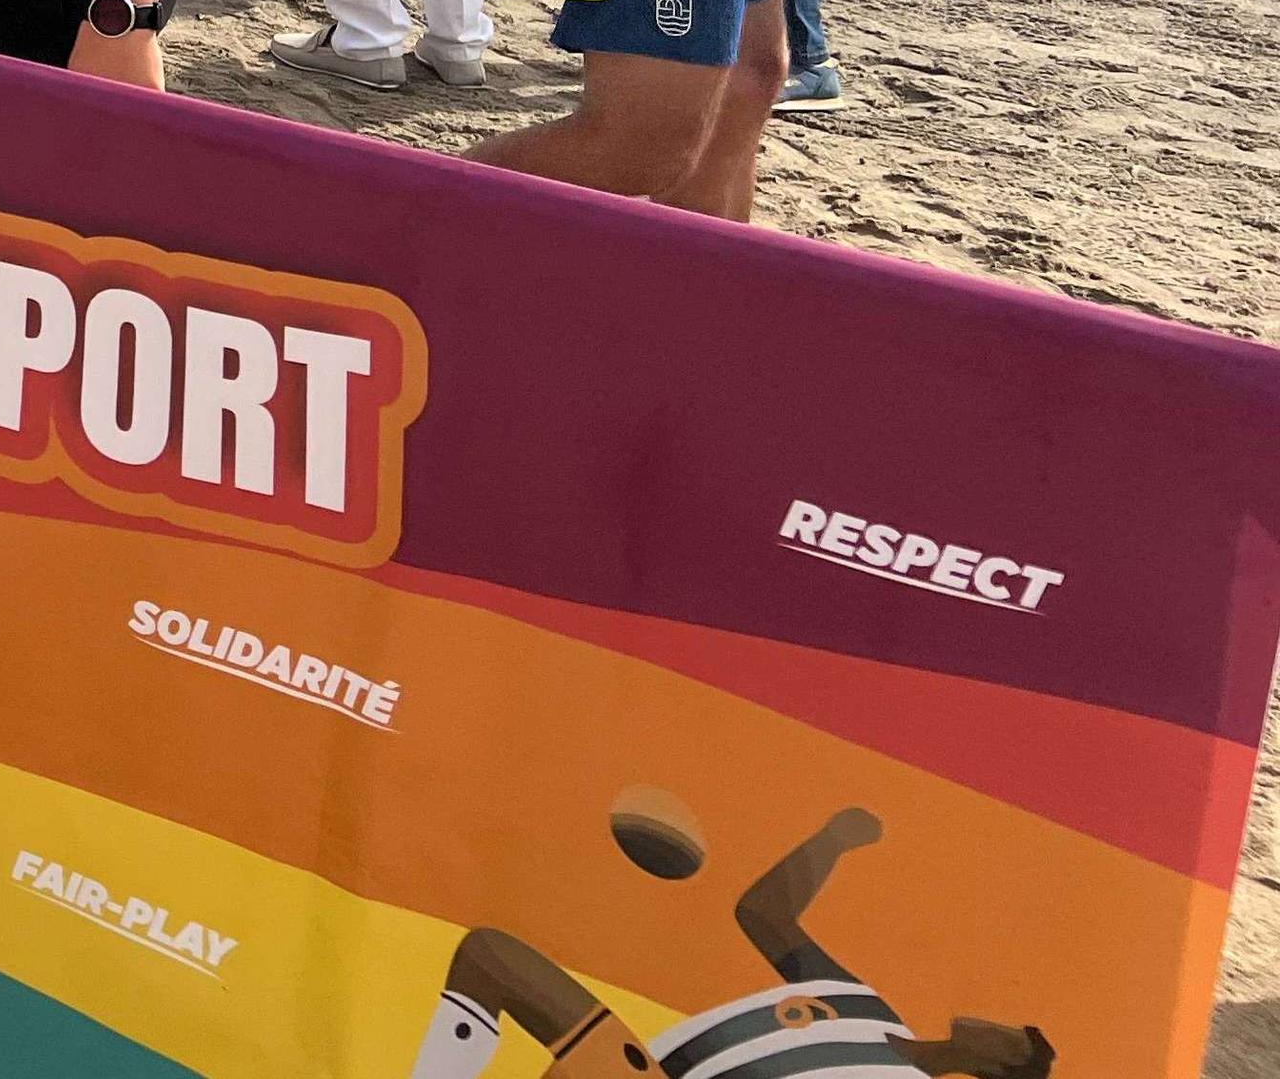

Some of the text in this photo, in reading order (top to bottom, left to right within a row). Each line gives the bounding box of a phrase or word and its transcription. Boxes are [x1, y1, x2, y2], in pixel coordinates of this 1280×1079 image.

[779, 499, 1065, 611] RESPECT
[127, 599, 401, 724] SOLIDARITÉ
[10, 850, 240, 966] FAIR-PLAY
